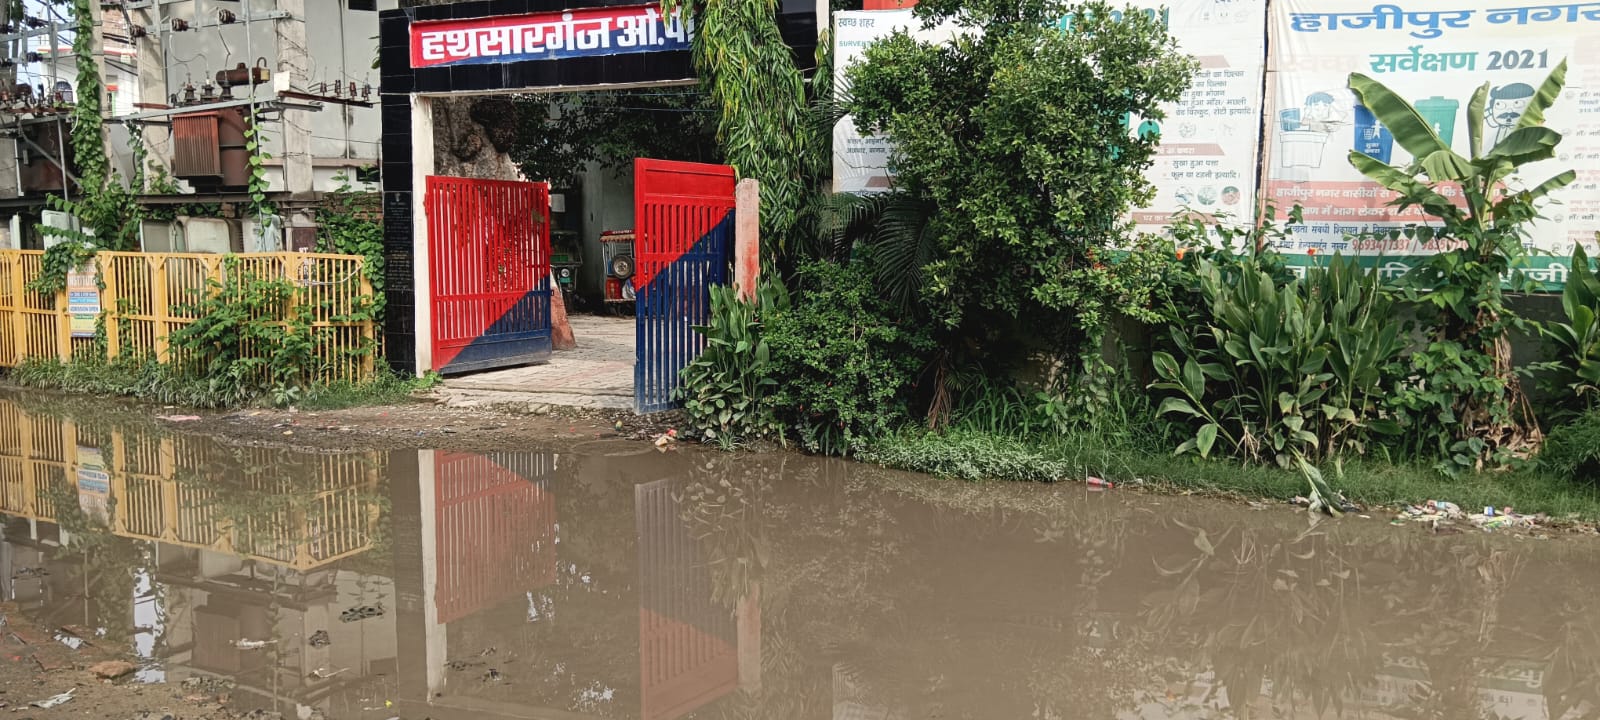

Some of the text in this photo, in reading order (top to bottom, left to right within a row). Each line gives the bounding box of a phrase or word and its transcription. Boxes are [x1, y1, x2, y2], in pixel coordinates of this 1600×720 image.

[859, 18, 875, 28] शहर
[1290, 5, 1477, 39] हाजीपुर
[421, 13, 612, 60] हथसारगंज
[1369, 45, 1478, 73] सर्वेक्षण
[1486, 48, 1548, 70] 2021
[1276, 187, 1313, 200] हाजीपुर
